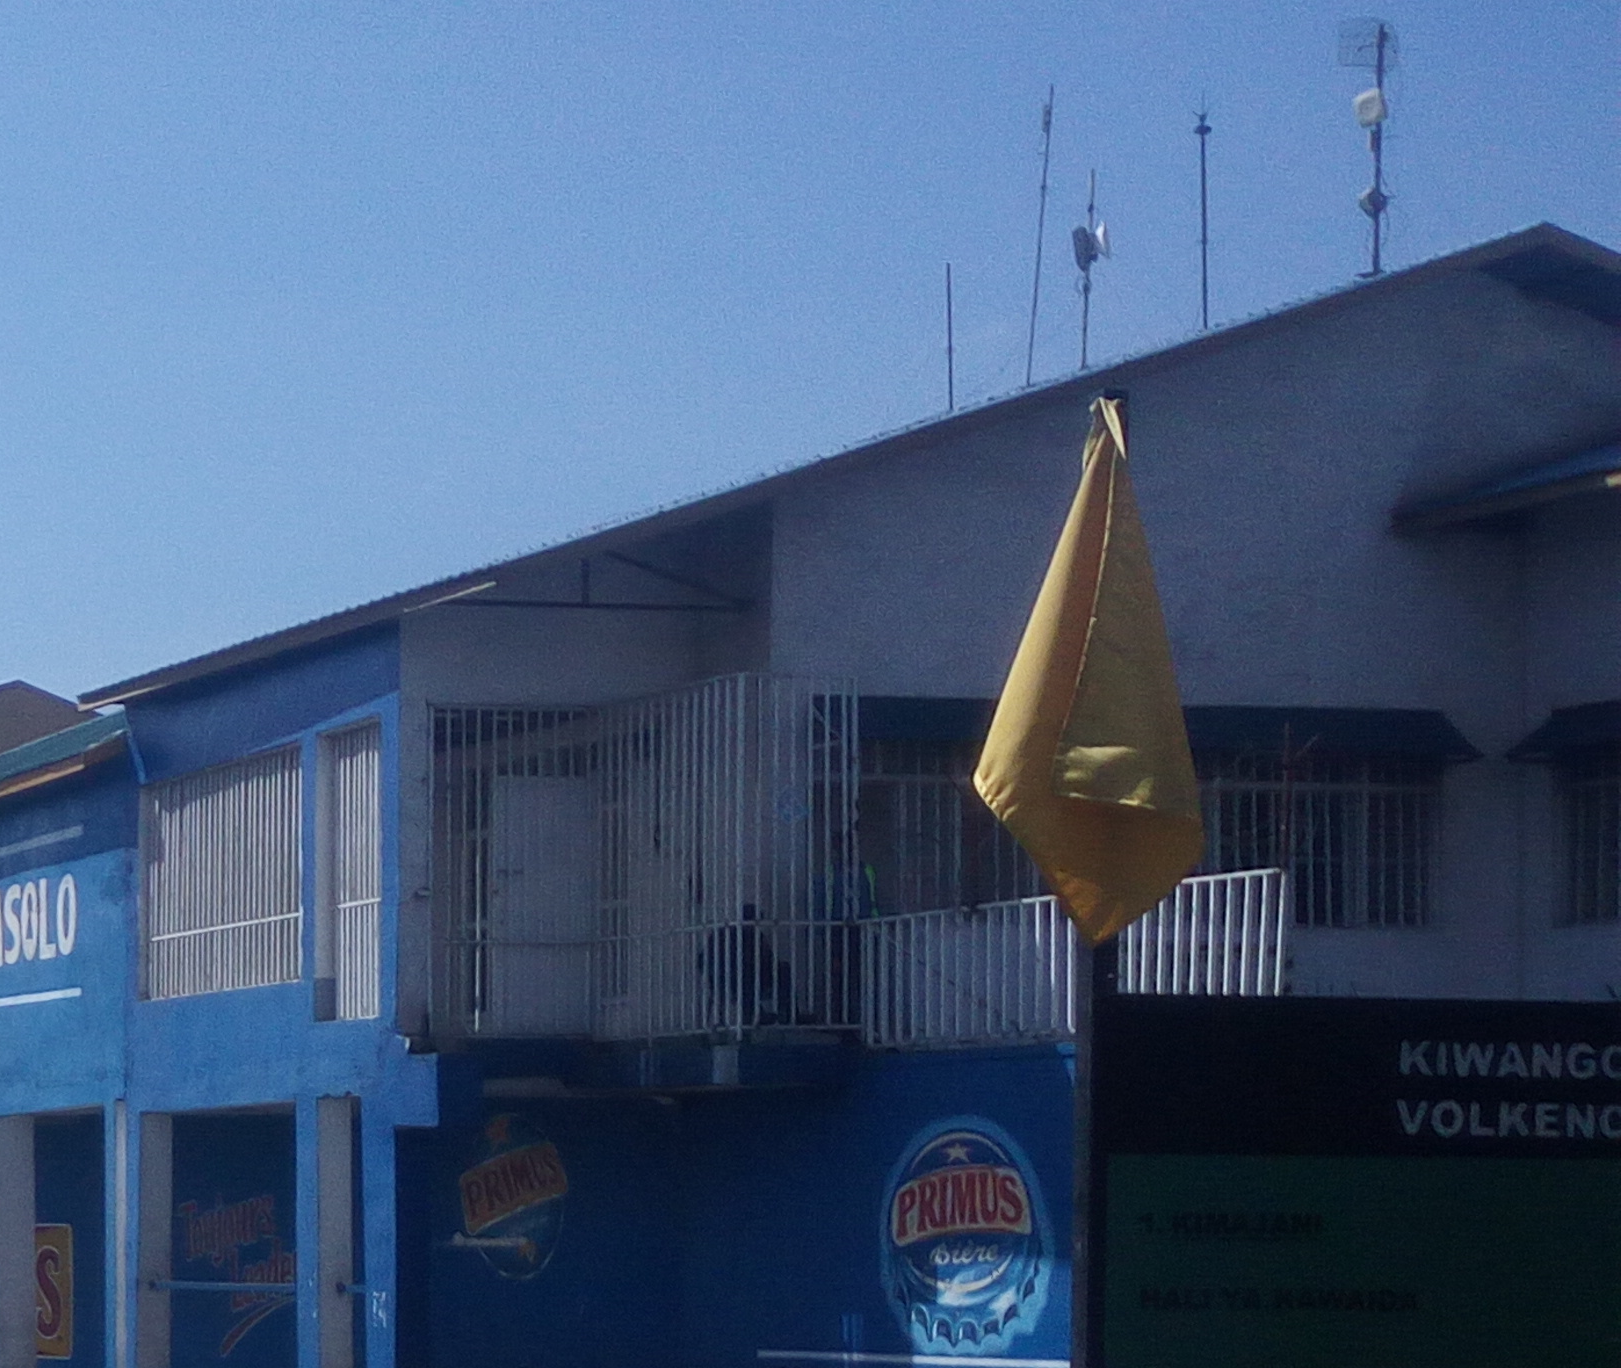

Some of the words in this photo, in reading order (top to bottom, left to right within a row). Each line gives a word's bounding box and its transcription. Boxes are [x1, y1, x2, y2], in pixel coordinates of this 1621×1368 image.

[465, 1151, 560, 1219] PRIMUS
[895, 1170, 1025, 1239] PRIMUS
[177, 1193, 277, 1266] Toujours
[229, 1237, 298, 1313] Leade
